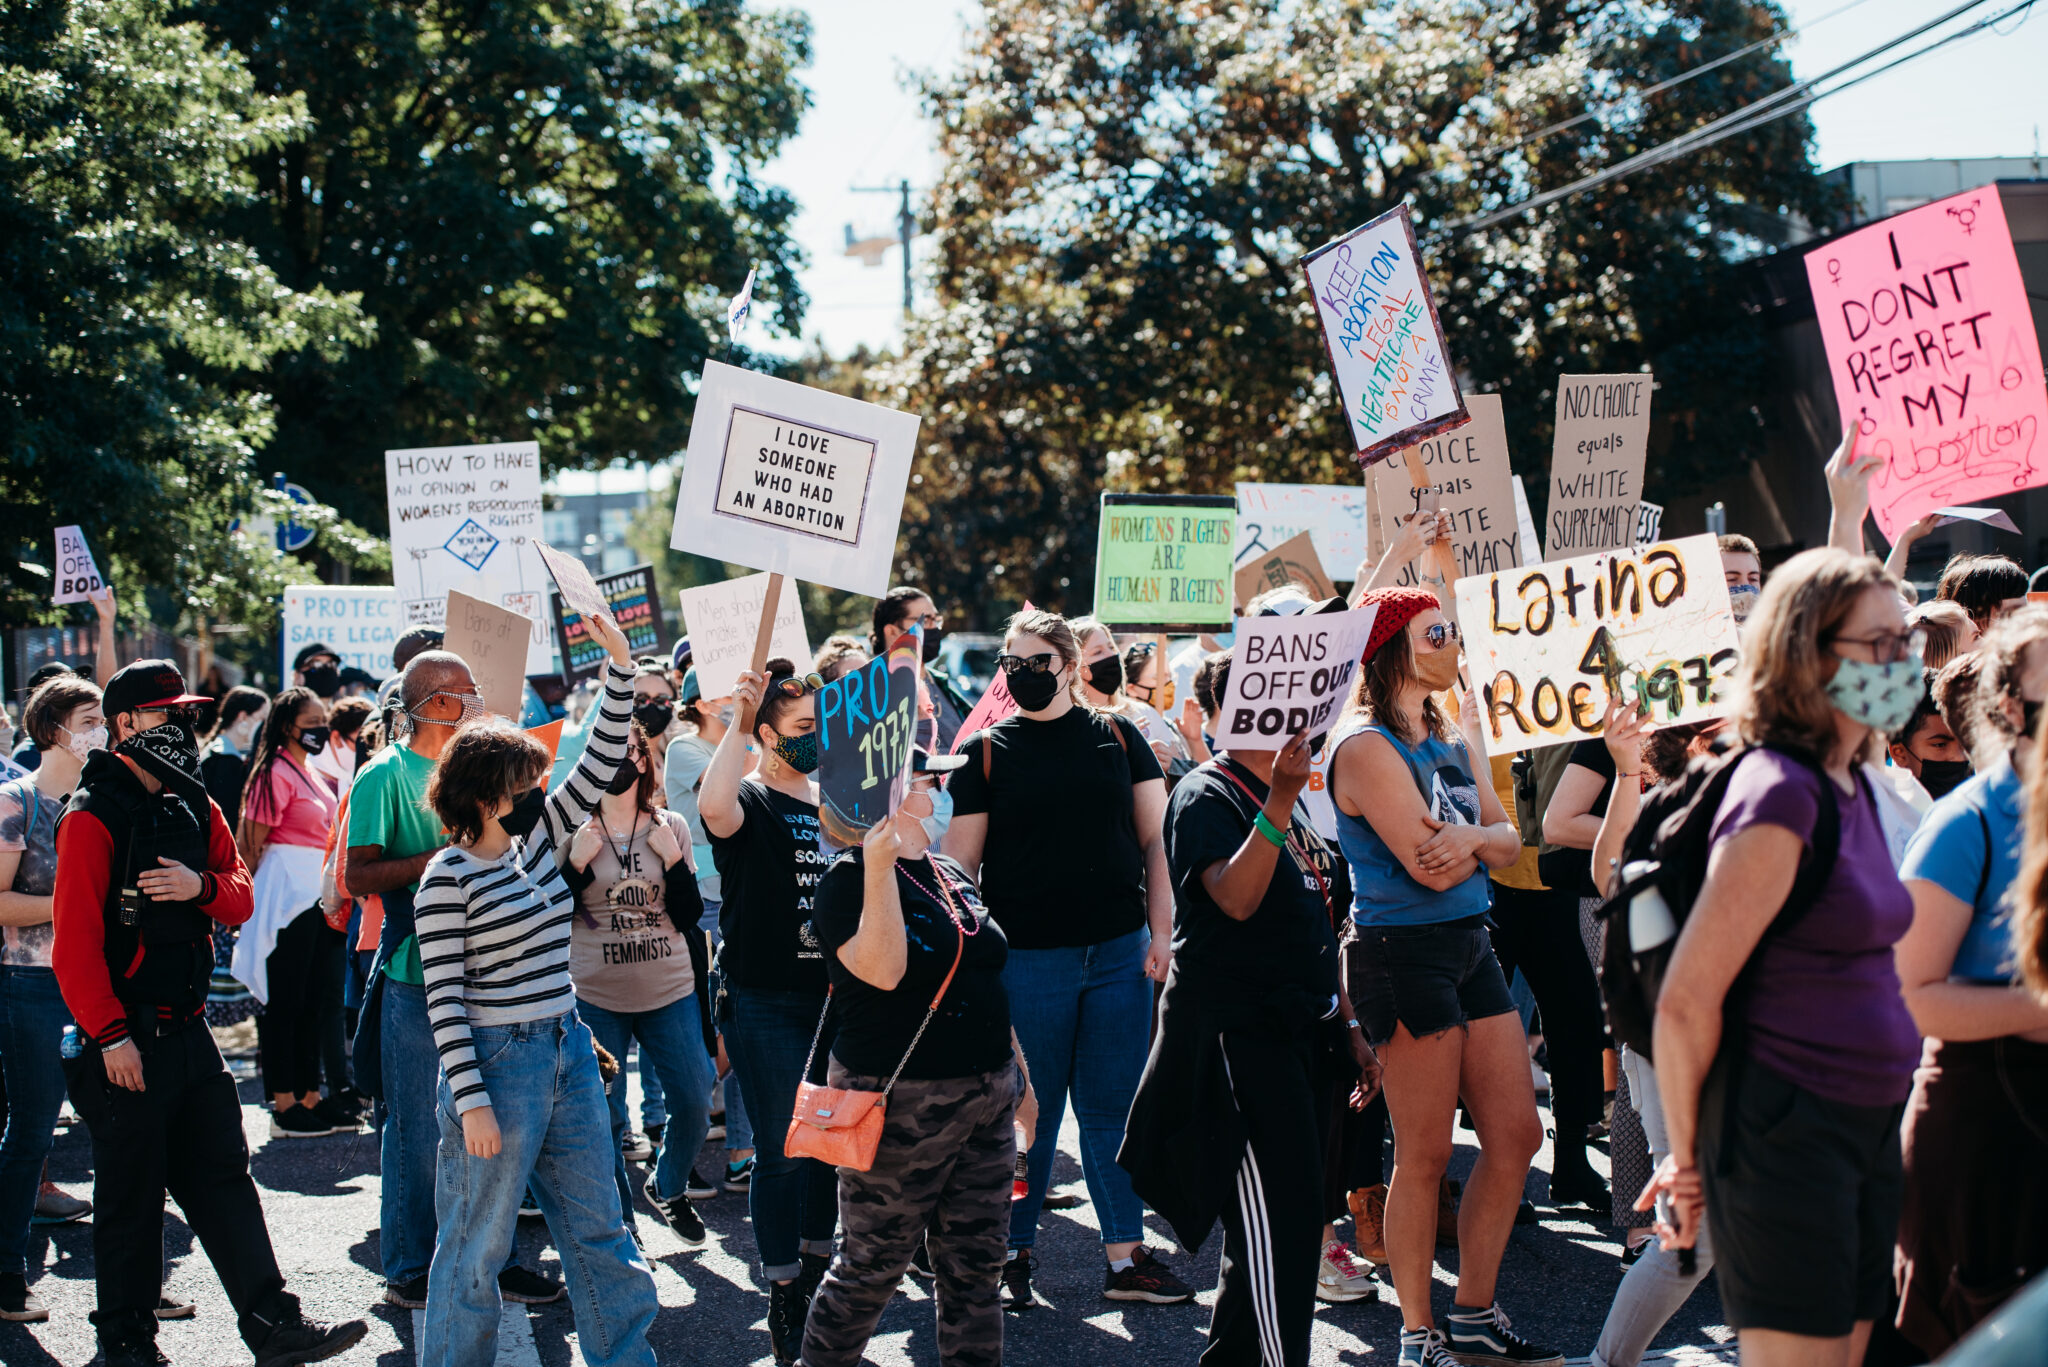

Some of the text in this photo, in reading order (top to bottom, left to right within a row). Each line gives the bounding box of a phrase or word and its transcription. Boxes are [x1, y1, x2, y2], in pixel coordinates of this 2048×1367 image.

[1889, 231, 1901, 270] I
[1321, 244, 1361, 318] KEEP
[1339, 241, 1400, 358] ABORTION
[1842, 261, 1970, 342] DONT
[1360, 289, 1413, 363] LEGAL
[1411, 334, 1427, 354] A
[1846, 311, 1992, 399] REGRET
[1357, 300, 1423, 434] HEALTHCARE
[1411, 350, 1443, 422] CRIME
[1564, 381, 1643, 420] NO CHOICE
[1902, 374, 1971, 427] MY
[775, 427, 829, 454] I LOVE
[1577, 432, 1624, 465] equals
[396, 452, 534, 476] HOW TO HAVE
[758, 447, 837, 480] SOMEONE
[394, 479, 509, 496] AN OPINION ON
[754, 470, 833, 504] WHO HAD
[1558, 470, 1628, 499] WHITE
[489, 513, 535, 527] RIGHTS
[733, 490, 845, 531] AN ABORTION
[1552, 504, 1636, 551] SUPREMACY
[510, 536, 525, 545] NO
[1110, 516, 1231, 545] WOMENS RIGHTS
[406, 548, 427, 560] YES
[1151, 545, 1186, 570] ARE
[304, 597, 397, 618] PROTEC
[1108, 576, 1225, 605] HUMAN RIGHTS
[291, 625, 336, 643] SAFE
[1245, 632, 1328, 665] BANS
[1240, 660, 1354, 700] OFF OUR
[1578, 625, 1624, 706] 4
[821, 656, 889, 751] PRO
[1230, 697, 1335, 736] BODIES
[859, 696, 909, 790] 1973
[602, 936, 672, 965] FEMINISTS
